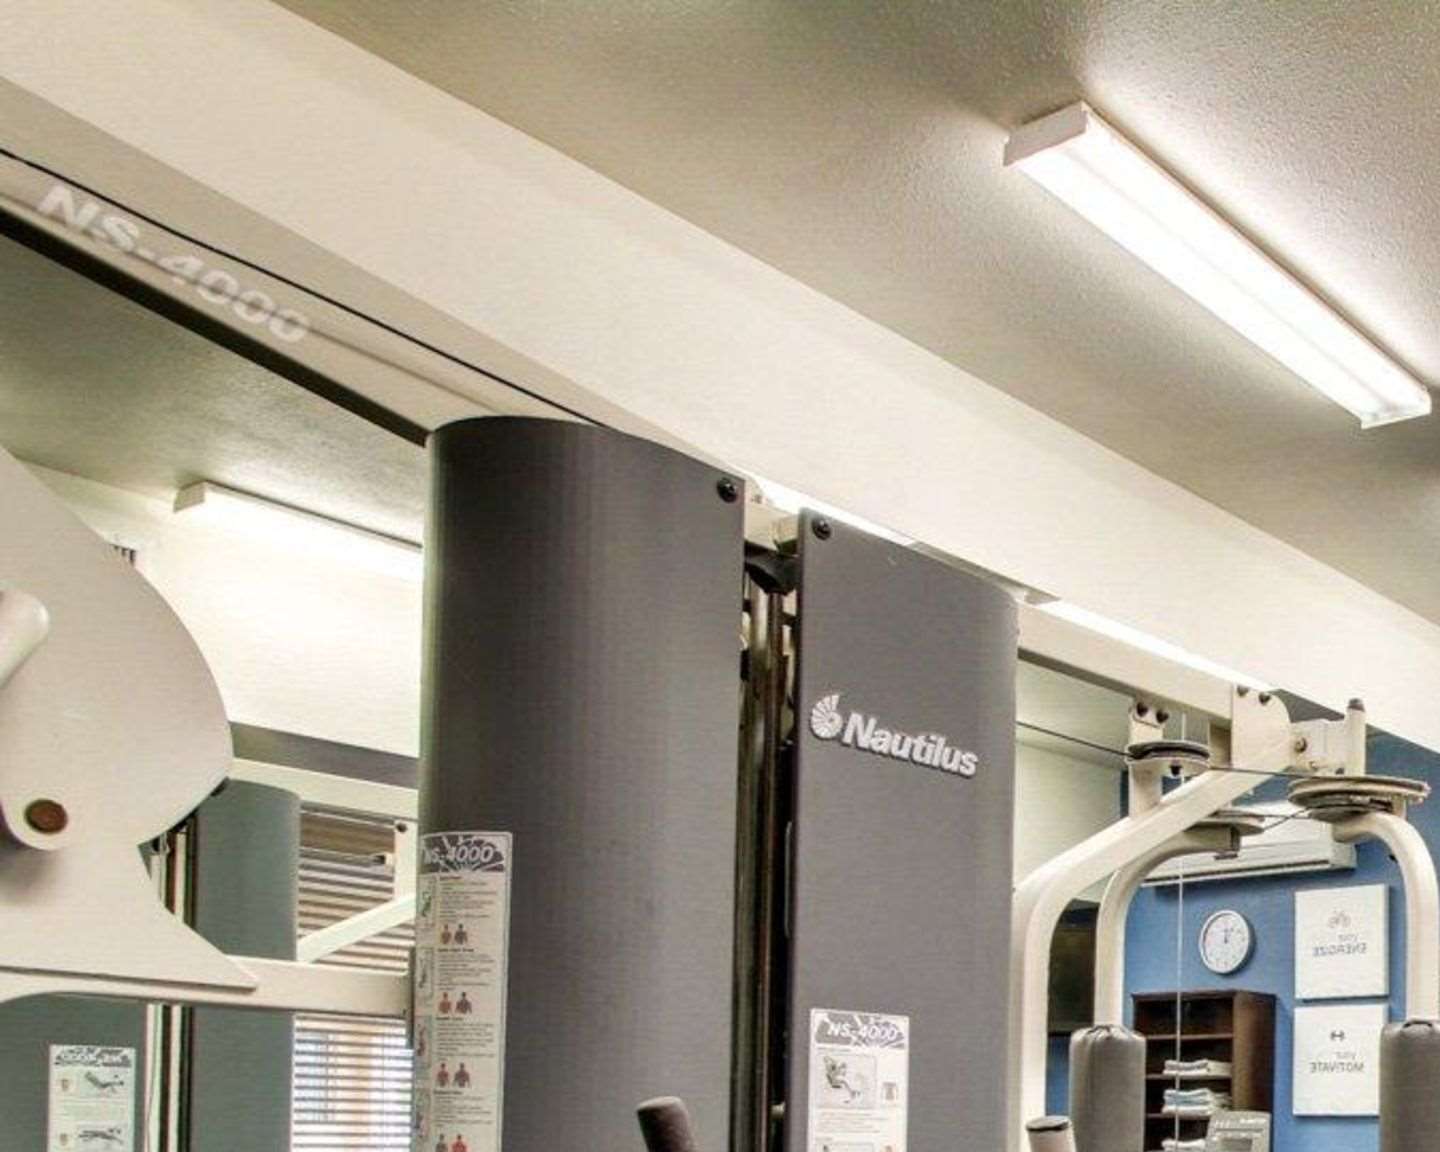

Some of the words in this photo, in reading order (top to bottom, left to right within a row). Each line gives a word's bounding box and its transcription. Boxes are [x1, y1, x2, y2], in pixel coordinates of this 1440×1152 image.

[36, 184, 309, 342] NS-4000
[842, 711, 979, 777] Nautilus
[827, 1021, 898, 1040] NS-4000
